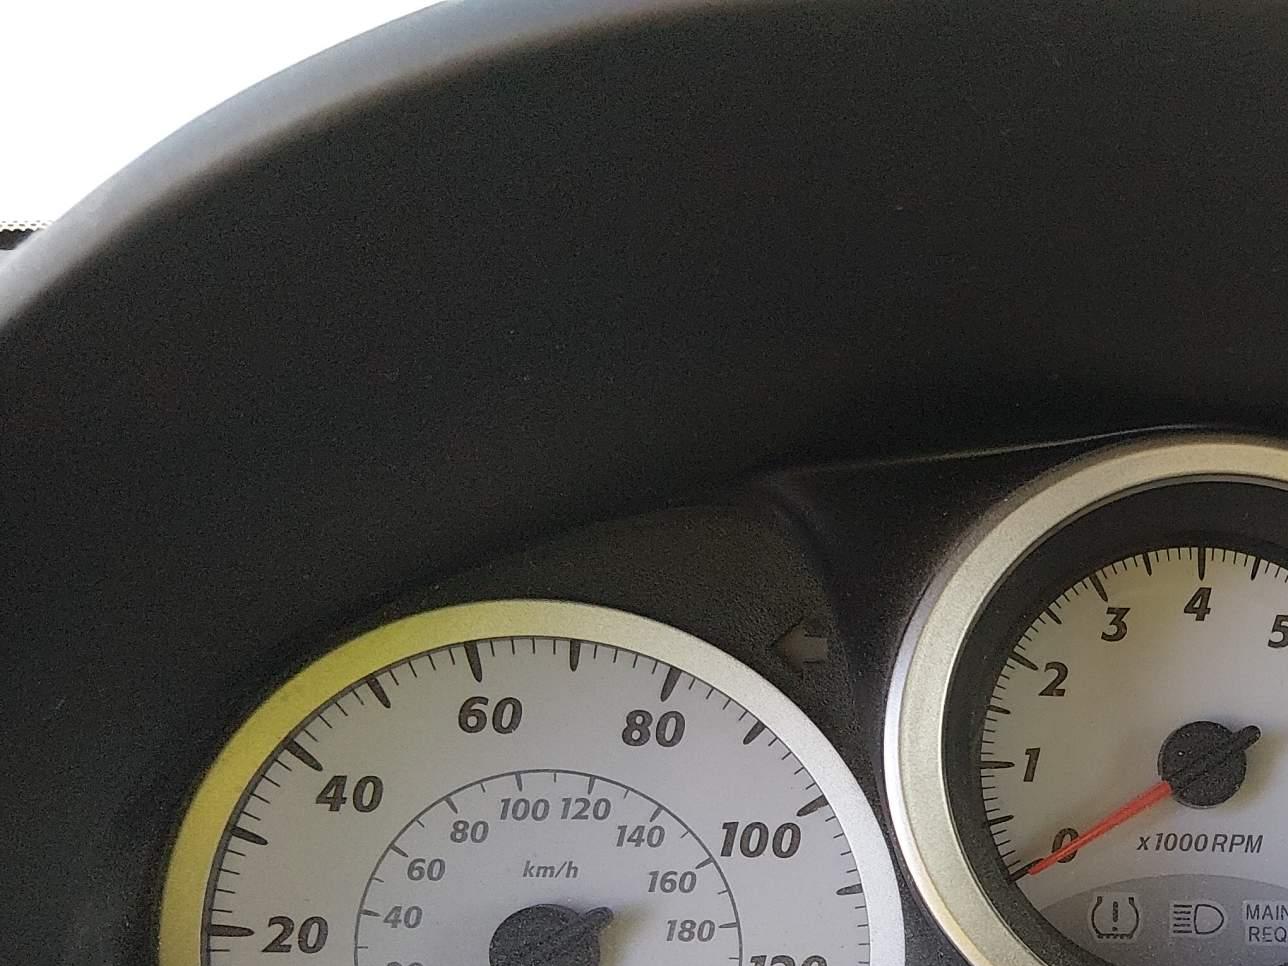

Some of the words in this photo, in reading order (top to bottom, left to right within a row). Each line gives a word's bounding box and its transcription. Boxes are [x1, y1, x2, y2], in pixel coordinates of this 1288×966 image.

[1183, 586, 1212, 621] 4
[1101, 606, 1130, 642] 3
[1039, 661, 1069, 698] 2
[458, 696, 522, 734] 60
[621, 709, 686, 748] 80
[1022, 746, 1042, 782] 1
[316, 774, 384, 814] 40
[499, 797, 549, 821] 100
[560, 797, 612, 821] 120
[449, 820, 490, 844] 80
[616, 824, 665, 849] 140
[719, 820, 802, 859] 100
[406, 857, 447, 882] 60
[522, 859, 579, 880] km/h
[647, 869, 697, 894] 160
[383, 905, 423, 930] 40
[665, 918, 716, 943] 180
[261, 915, 329, 954] 20
